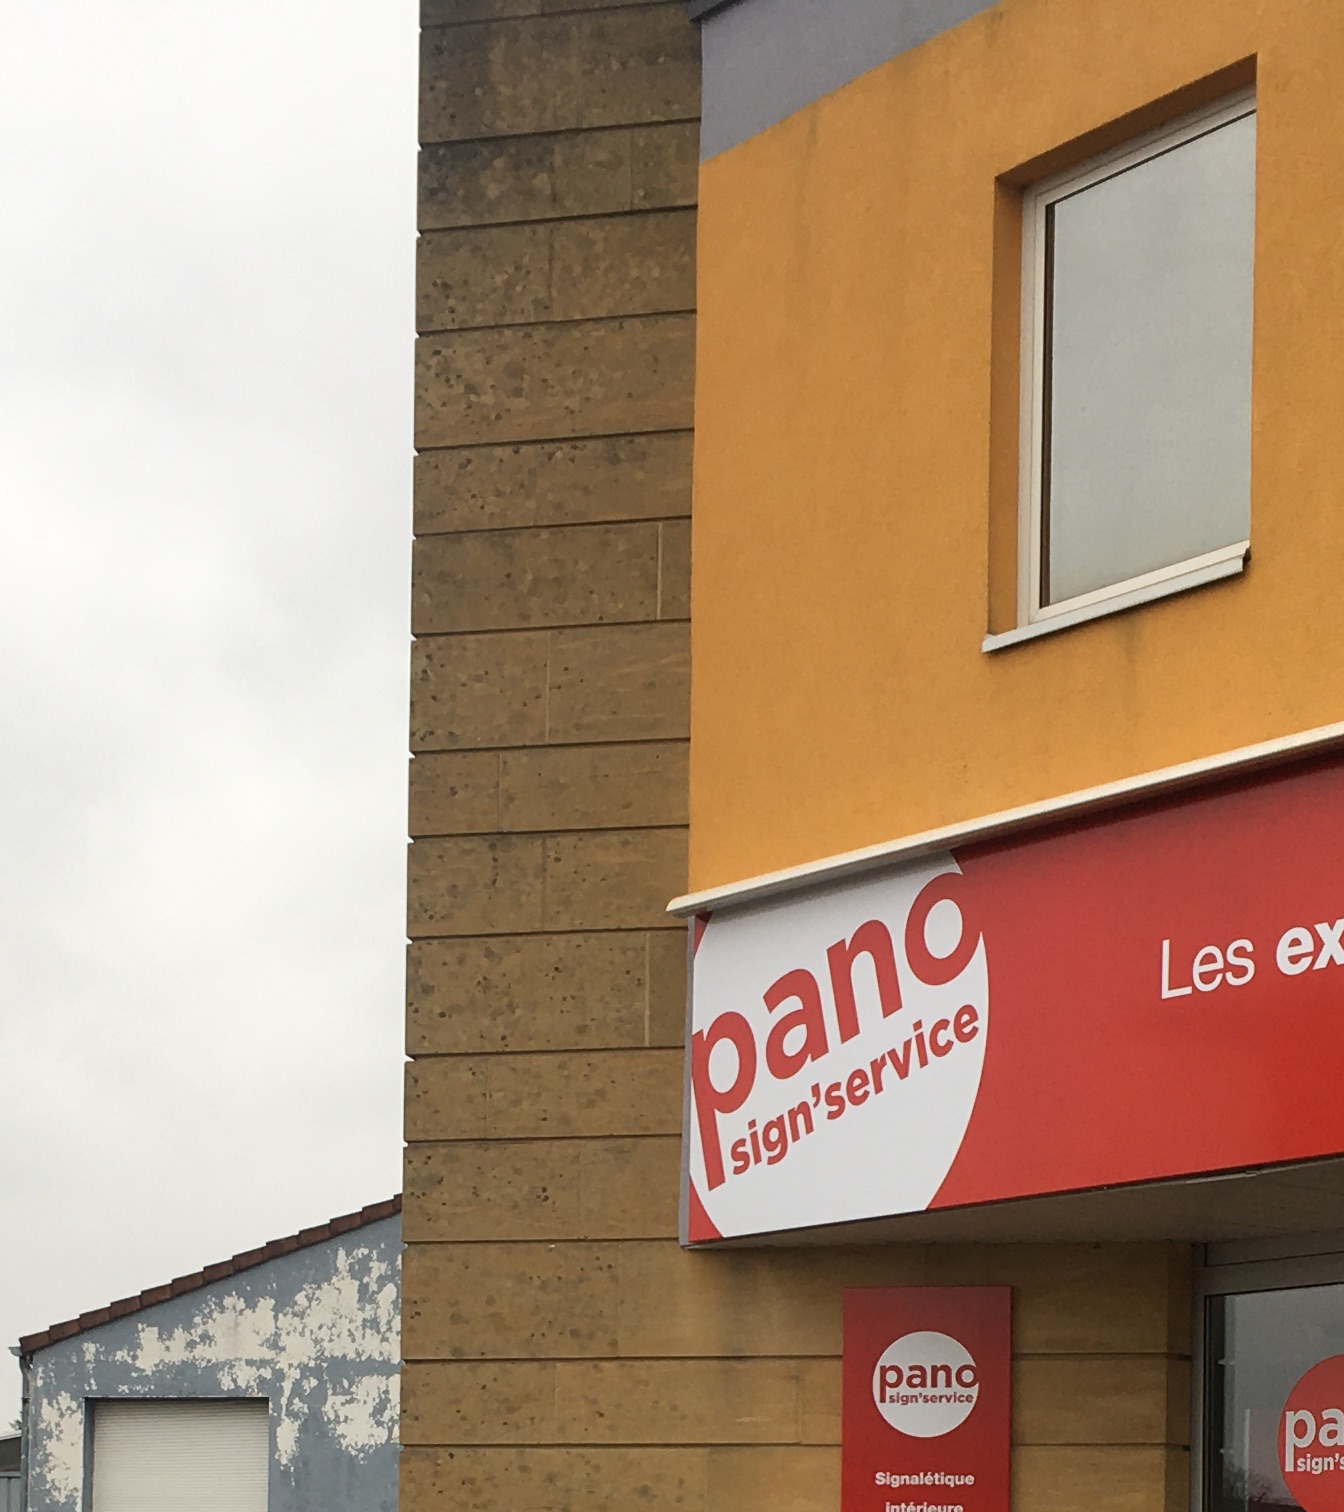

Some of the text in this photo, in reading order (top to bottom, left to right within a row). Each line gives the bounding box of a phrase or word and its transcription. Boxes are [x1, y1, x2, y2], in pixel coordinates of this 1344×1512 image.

[1160, 939, 1255, 999] Les
[692, 872, 981, 1191] pano
[730, 1004, 979, 1175] sign'service
[879, 1364, 980, 1403] pano
[888, 1392, 974, 1406] sign'service
[875, 1471, 975, 1488] Signalétique
